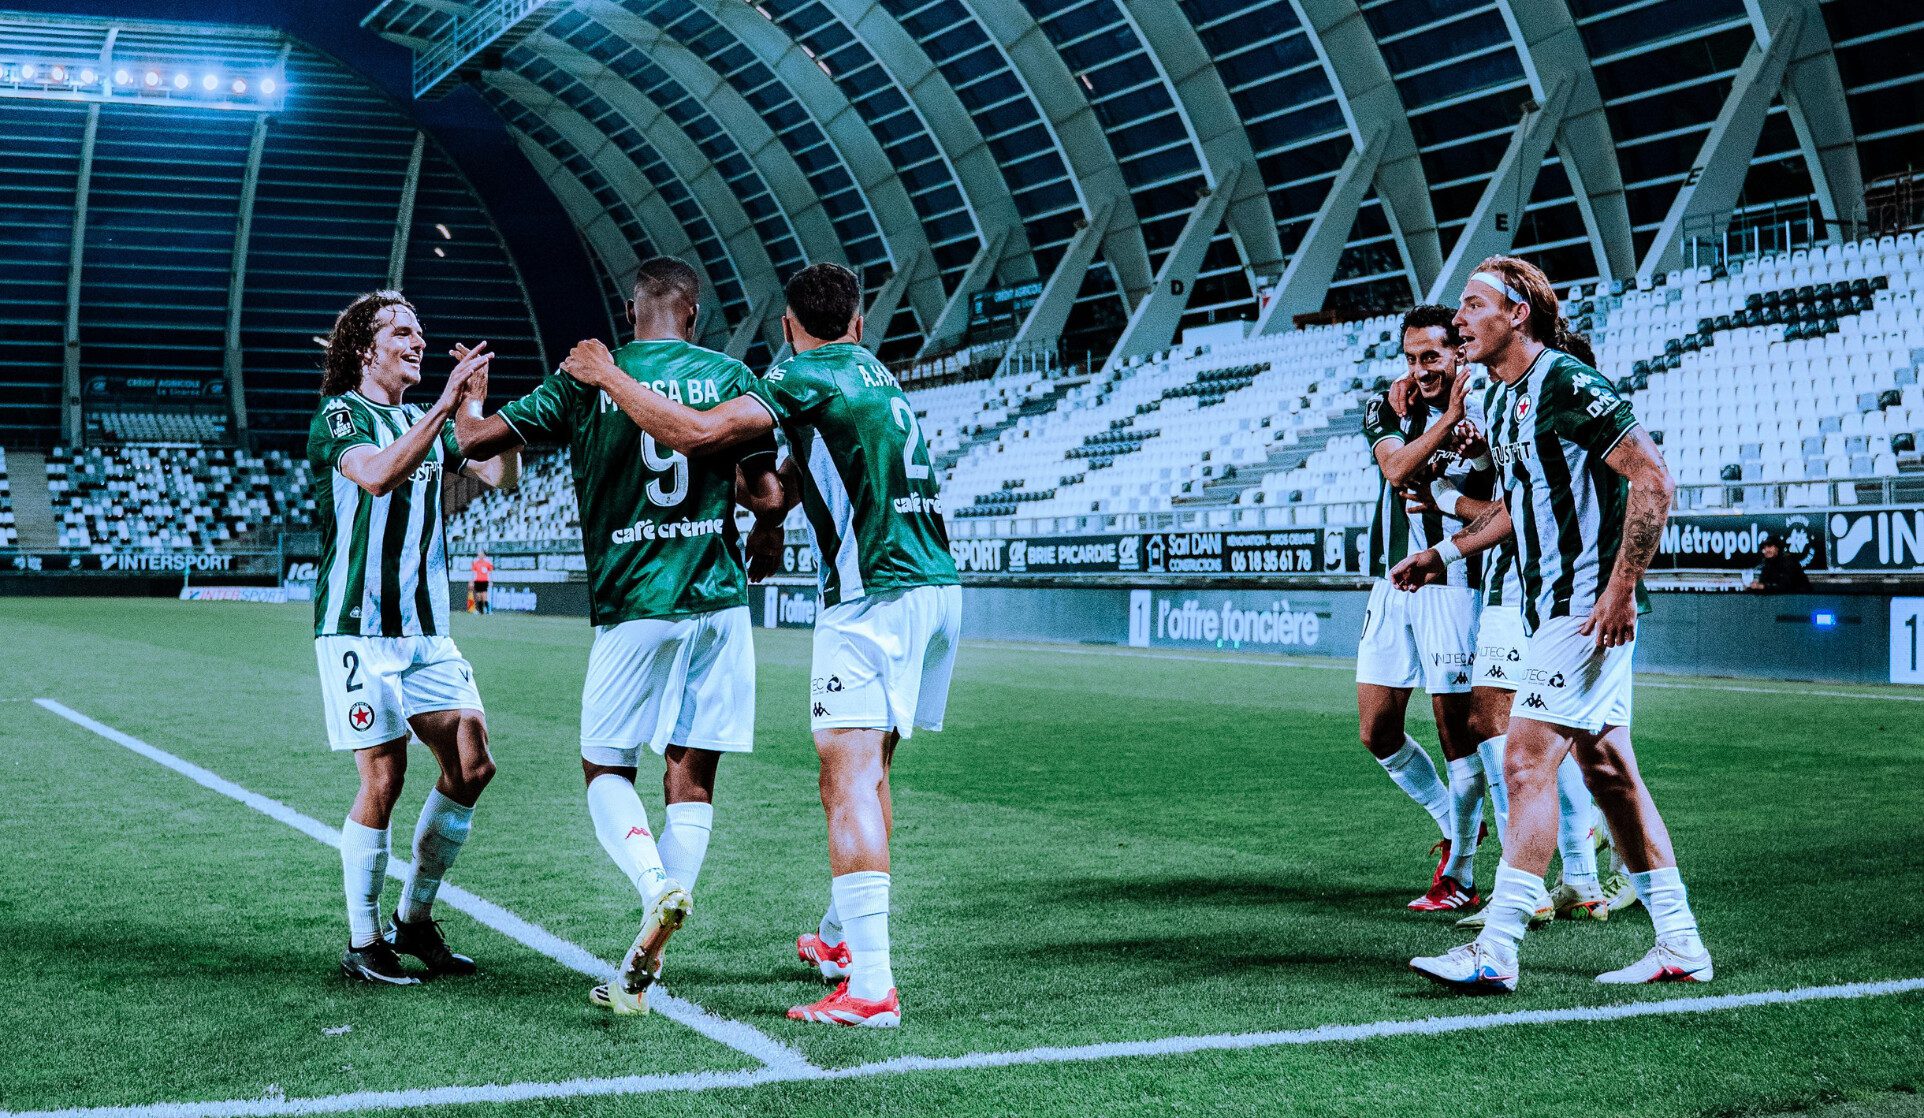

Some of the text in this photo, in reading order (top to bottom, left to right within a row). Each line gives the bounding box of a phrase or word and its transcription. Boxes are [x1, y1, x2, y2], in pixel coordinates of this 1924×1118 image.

[1684, 167, 1703, 187] E
[1495, 213, 1509, 232] E
[1170, 279, 1184, 296] D
[687, 379, 721, 404] BA
[892, 396, 929, 480] 2
[641, 429, 689, 507] 9
[611, 516, 724, 545] café crème
[1027, 546, 1056, 565] BRIE
[1057, 543, 1116, 564] PICARDIE
[1191, 532, 1222, 556] DANI
[118, 554, 233, 572] INTERSPORT
[288, 562, 319, 580] IG
[1231, 550, 1247, 572] 06
[1247, 550, 1262, 572] 18
[1279, 549, 1294, 572] 61
[200, 588, 285, 602] INTERSPORT
[1157, 599, 1219, 642] l'offre
[1221, 599, 1319, 646] foncière
[342, 650, 364, 693] 2
